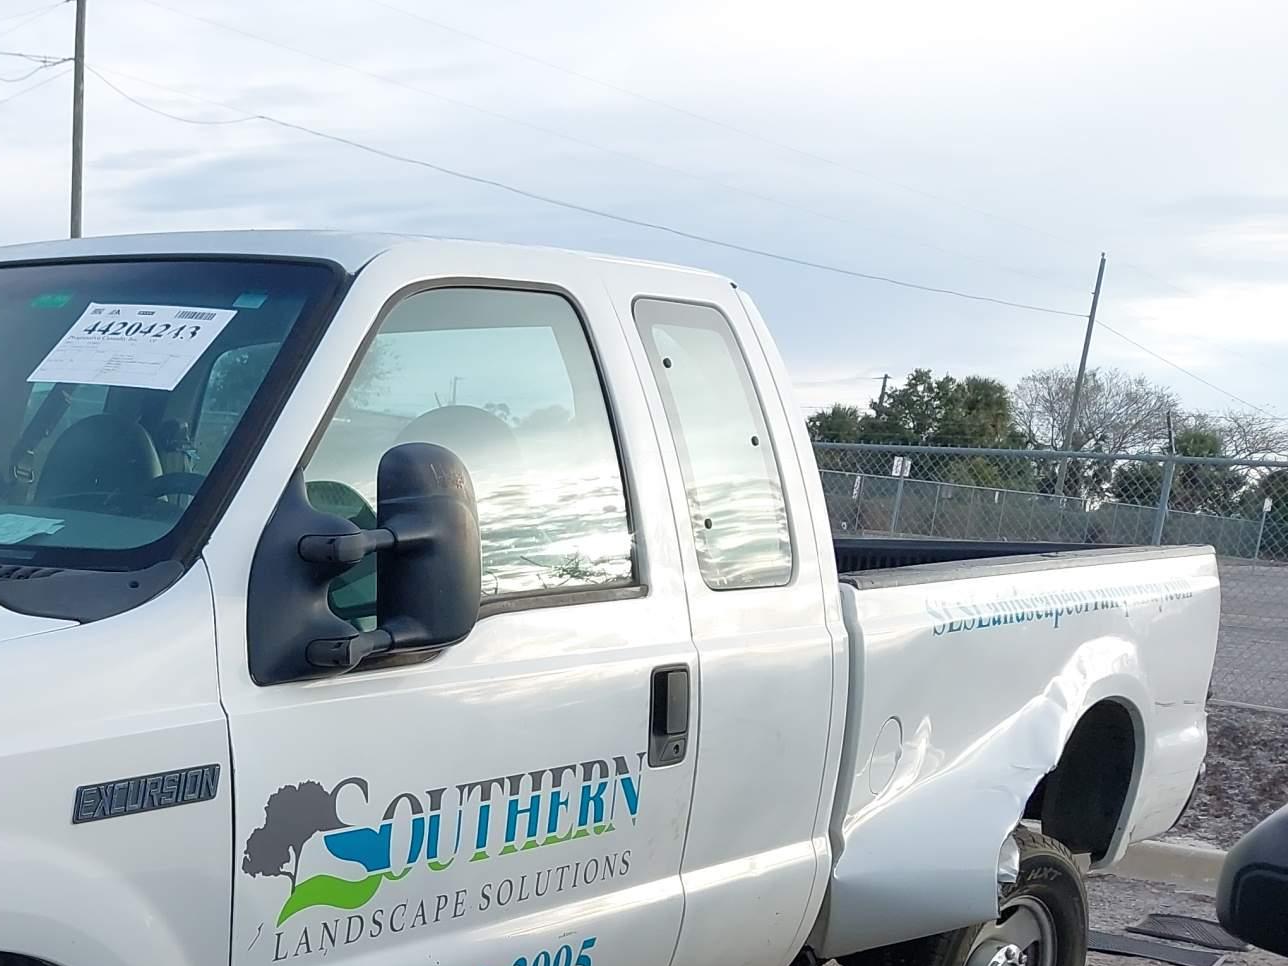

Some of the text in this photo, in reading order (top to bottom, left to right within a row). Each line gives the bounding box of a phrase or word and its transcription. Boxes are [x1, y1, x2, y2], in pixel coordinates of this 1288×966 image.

[78, 767, 220, 820] EXCURSION
[324, 751, 648, 880] SOUTHERN
[271, 849, 633, 962] LANDSCAPE SOLUTIONS
